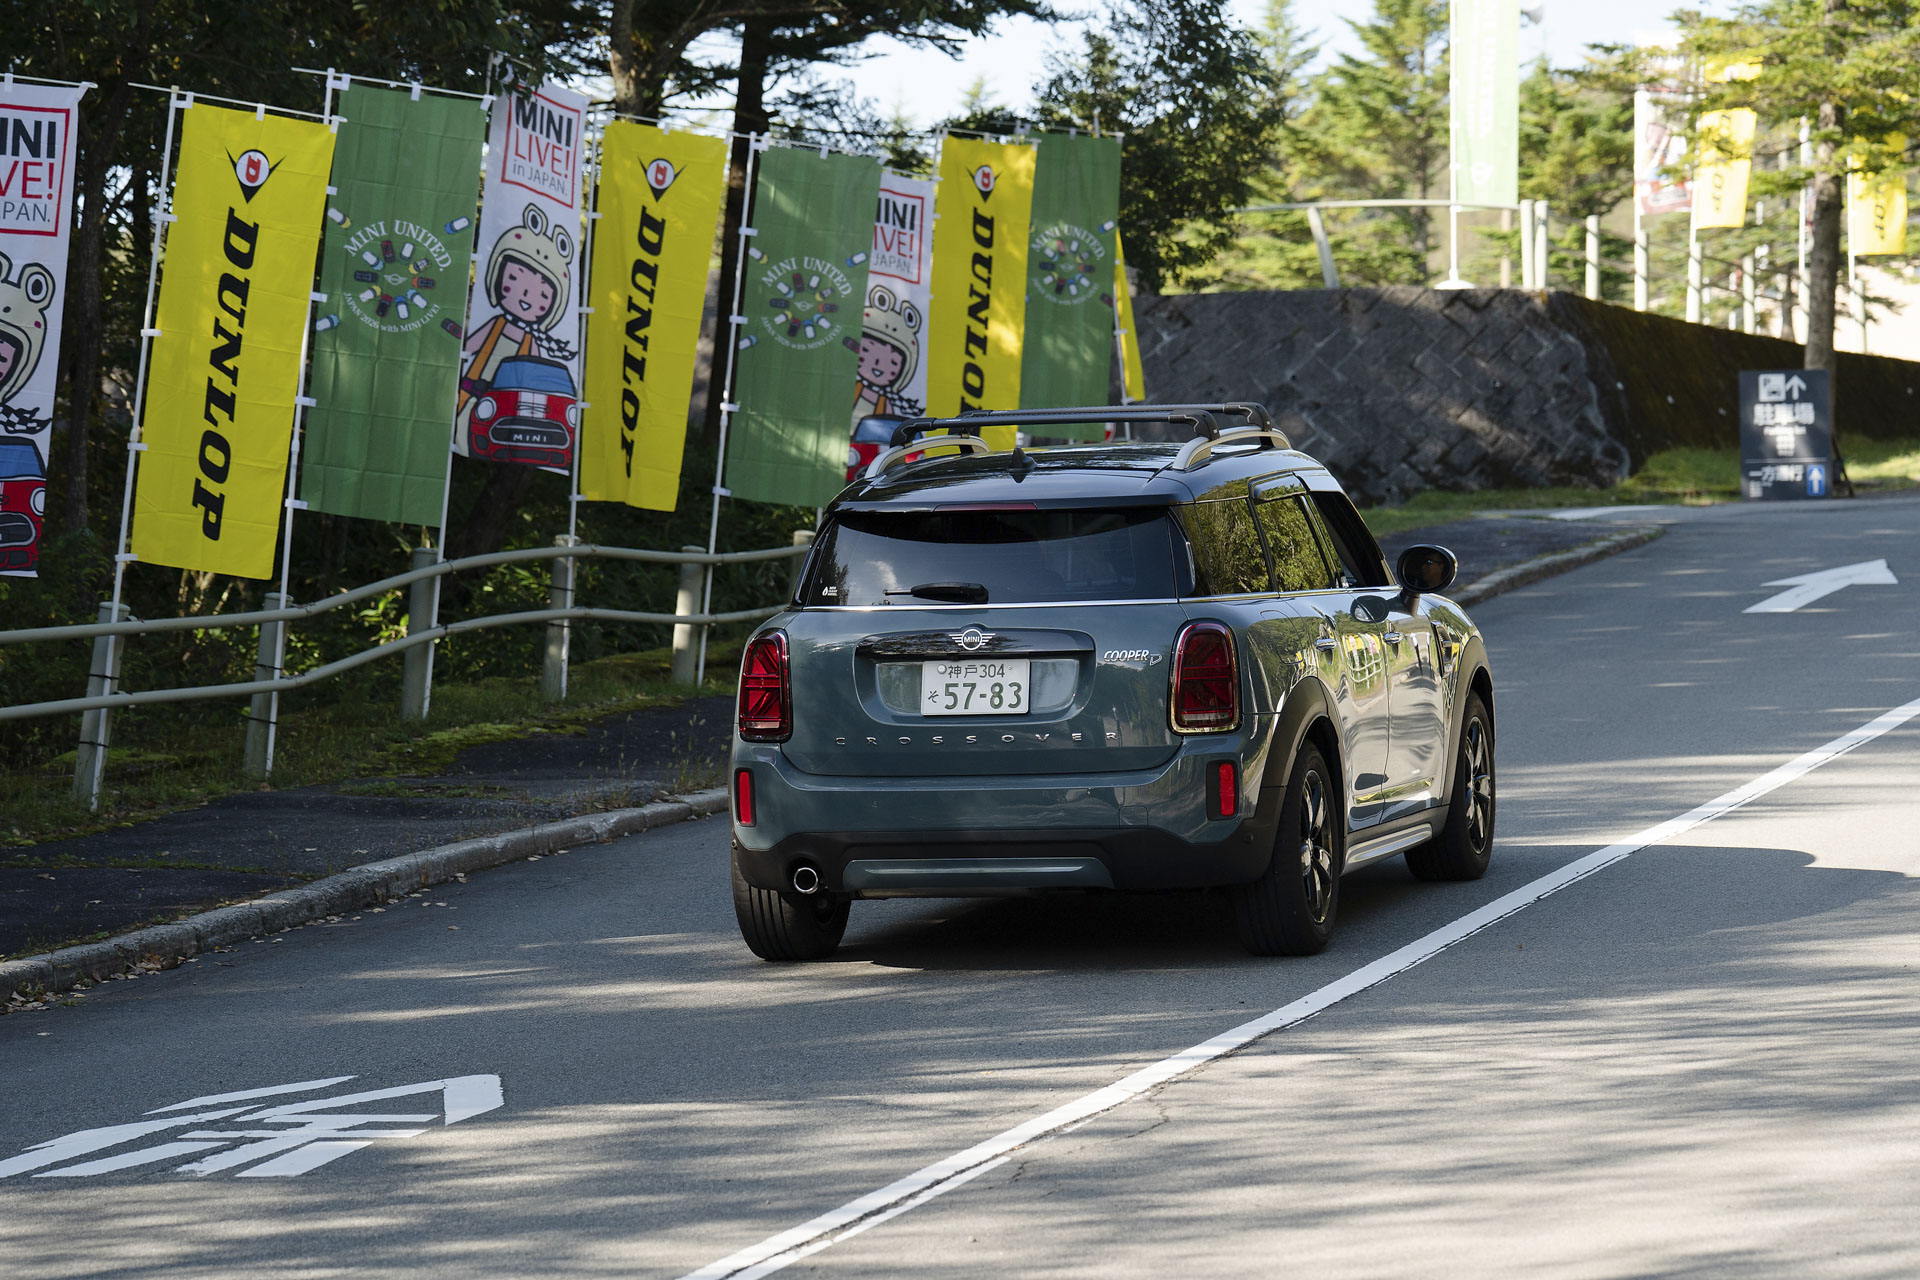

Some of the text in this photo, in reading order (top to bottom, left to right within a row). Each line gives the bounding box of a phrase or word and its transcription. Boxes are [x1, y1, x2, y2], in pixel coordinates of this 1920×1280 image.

[515, 96, 573, 148] MINI
[515, 127, 571, 179] LIVE!
[513, 160, 568, 197] in JAPAN.
[344, 220, 388, 257] MINI
[761, 257, 799, 287] MINI
[192, 206, 260, 542] DUNLOP
[513, 433, 548, 443] MINI
[1103, 649, 1150, 662] COOPER
[927, 681, 1023, 710] そ 57-83
[834, 732, 1118, 746] CROSSOVER
